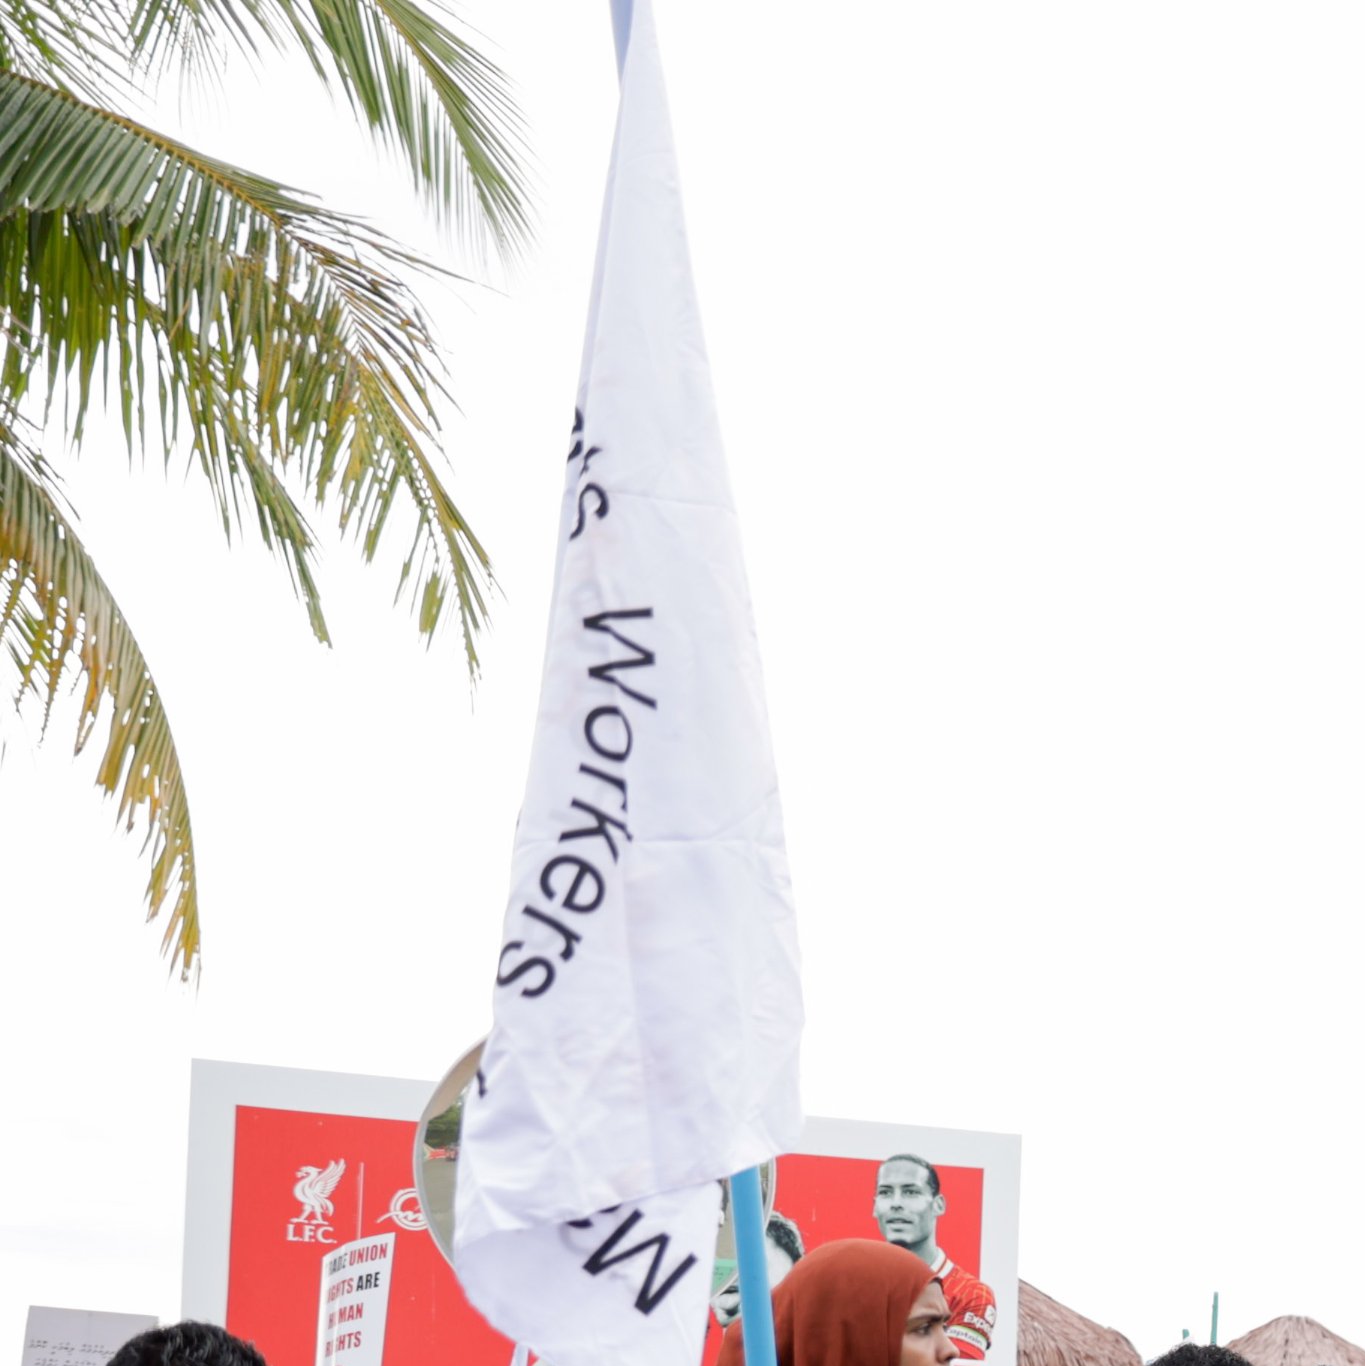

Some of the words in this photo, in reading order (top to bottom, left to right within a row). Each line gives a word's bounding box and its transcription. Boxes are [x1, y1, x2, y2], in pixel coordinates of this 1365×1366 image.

[497, 607, 658, 998] Workers
[349, 1243, 388, 1266] UNION
[327, 1278, 354, 1303] IGHTS
[356, 1271, 381, 1292] ARE
[328, 1302, 364, 1329] HMAN
